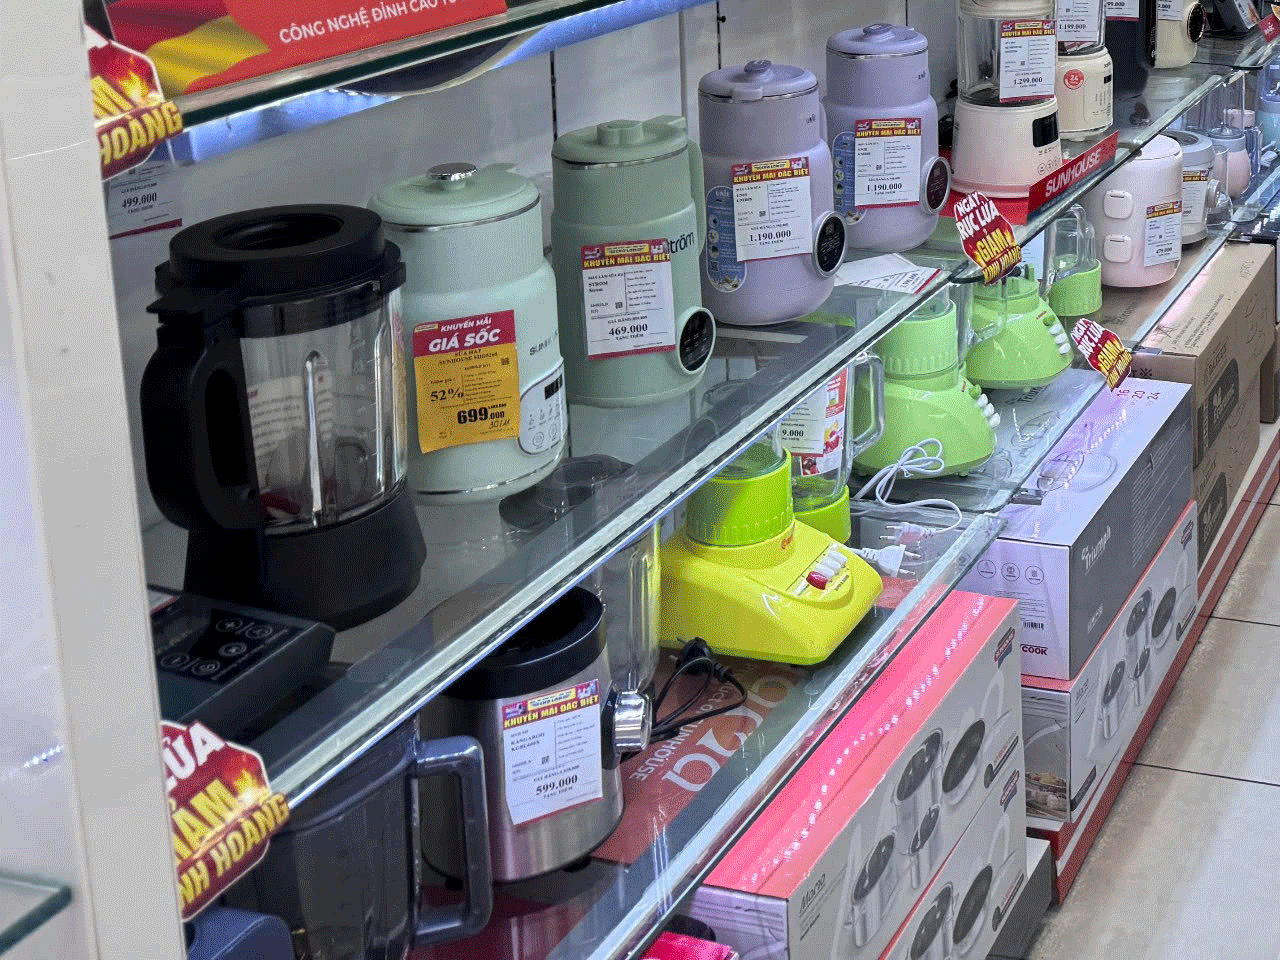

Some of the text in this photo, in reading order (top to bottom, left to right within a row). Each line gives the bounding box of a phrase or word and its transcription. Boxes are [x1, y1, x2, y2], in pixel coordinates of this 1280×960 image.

[279, 20, 325, 44] CÔNG
[327, 7, 370, 33] NGHỆ
[372, 1, 408, 22] ĐỈNH
[1013, 77, 1043, 85] 1.299.000
[1044, 149, 1101, 198] SUNHOUSE
[867, 183, 903, 192] 1.190.000
[122, 192, 157, 209] 499.000
[955, 192, 979, 216] NGÀY
[956, 200, 999, 240] RỰC LỬA
[670, 231, 695, 254] tröm
[750, 230, 792, 242] 1.190.000
[976, 228, 1010, 262] GIẢM
[440, 317, 492, 332] KHUYẾN MÃI
[609, 323, 648, 336] 469.000
[428, 325, 501, 352] GIÁ SỐC
[430, 388, 464, 402] 52%
[457, 406, 505, 425] 699.000
[535, 775, 578, 796] 599.000
[209, 792, 289, 878] HOÀNG
